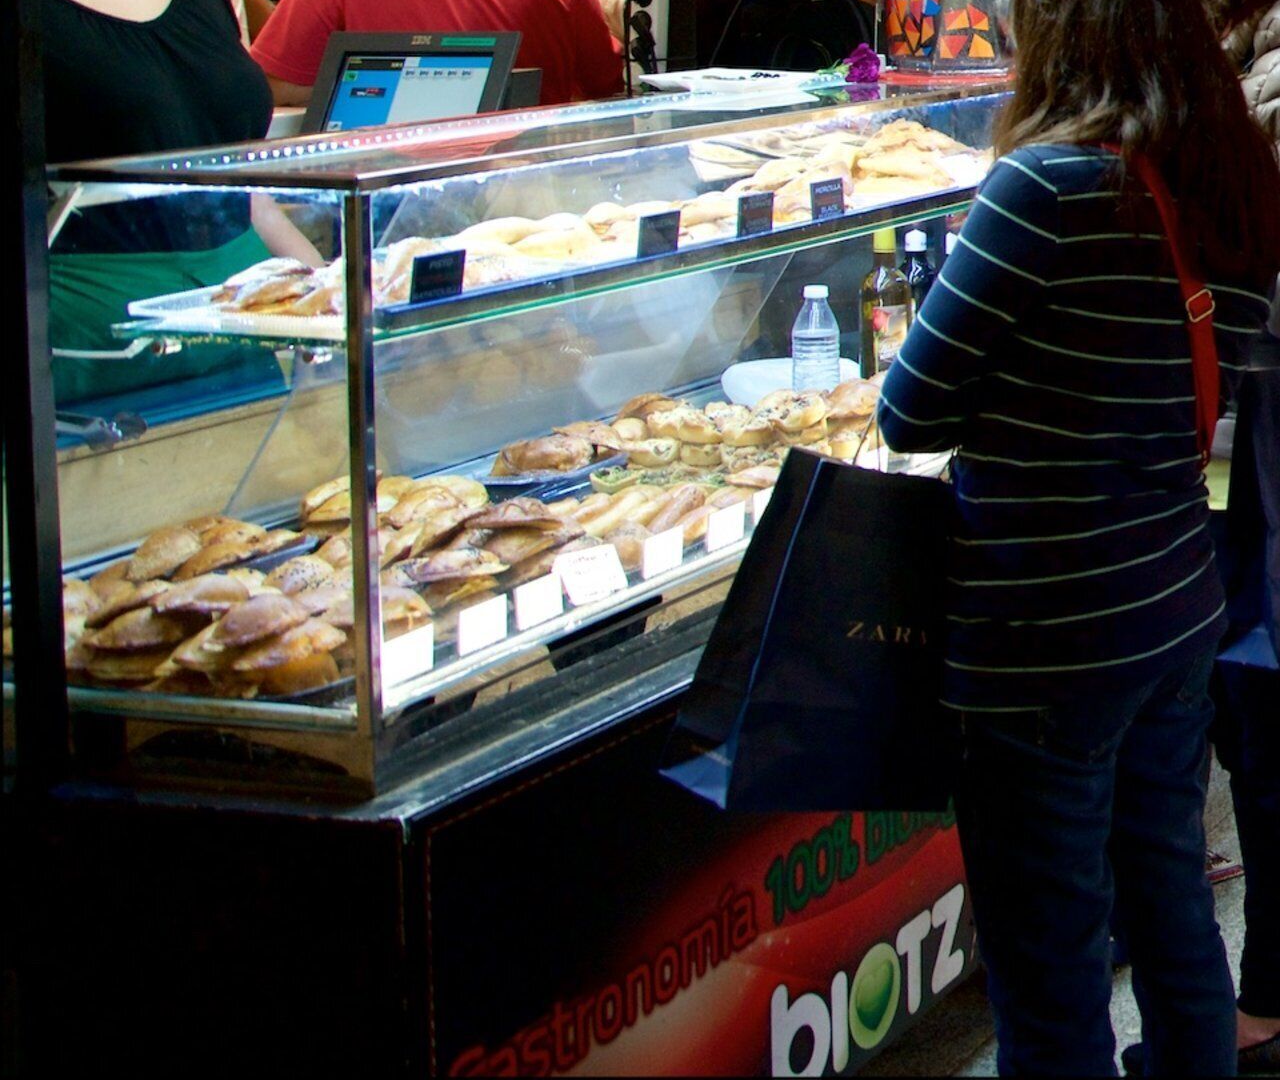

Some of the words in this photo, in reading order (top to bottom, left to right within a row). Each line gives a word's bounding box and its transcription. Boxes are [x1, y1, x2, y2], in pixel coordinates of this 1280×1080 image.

[411, 35, 432, 46] IBM
[845, 620, 928, 647] ZARA
[763, 816, 860, 925] 100%
